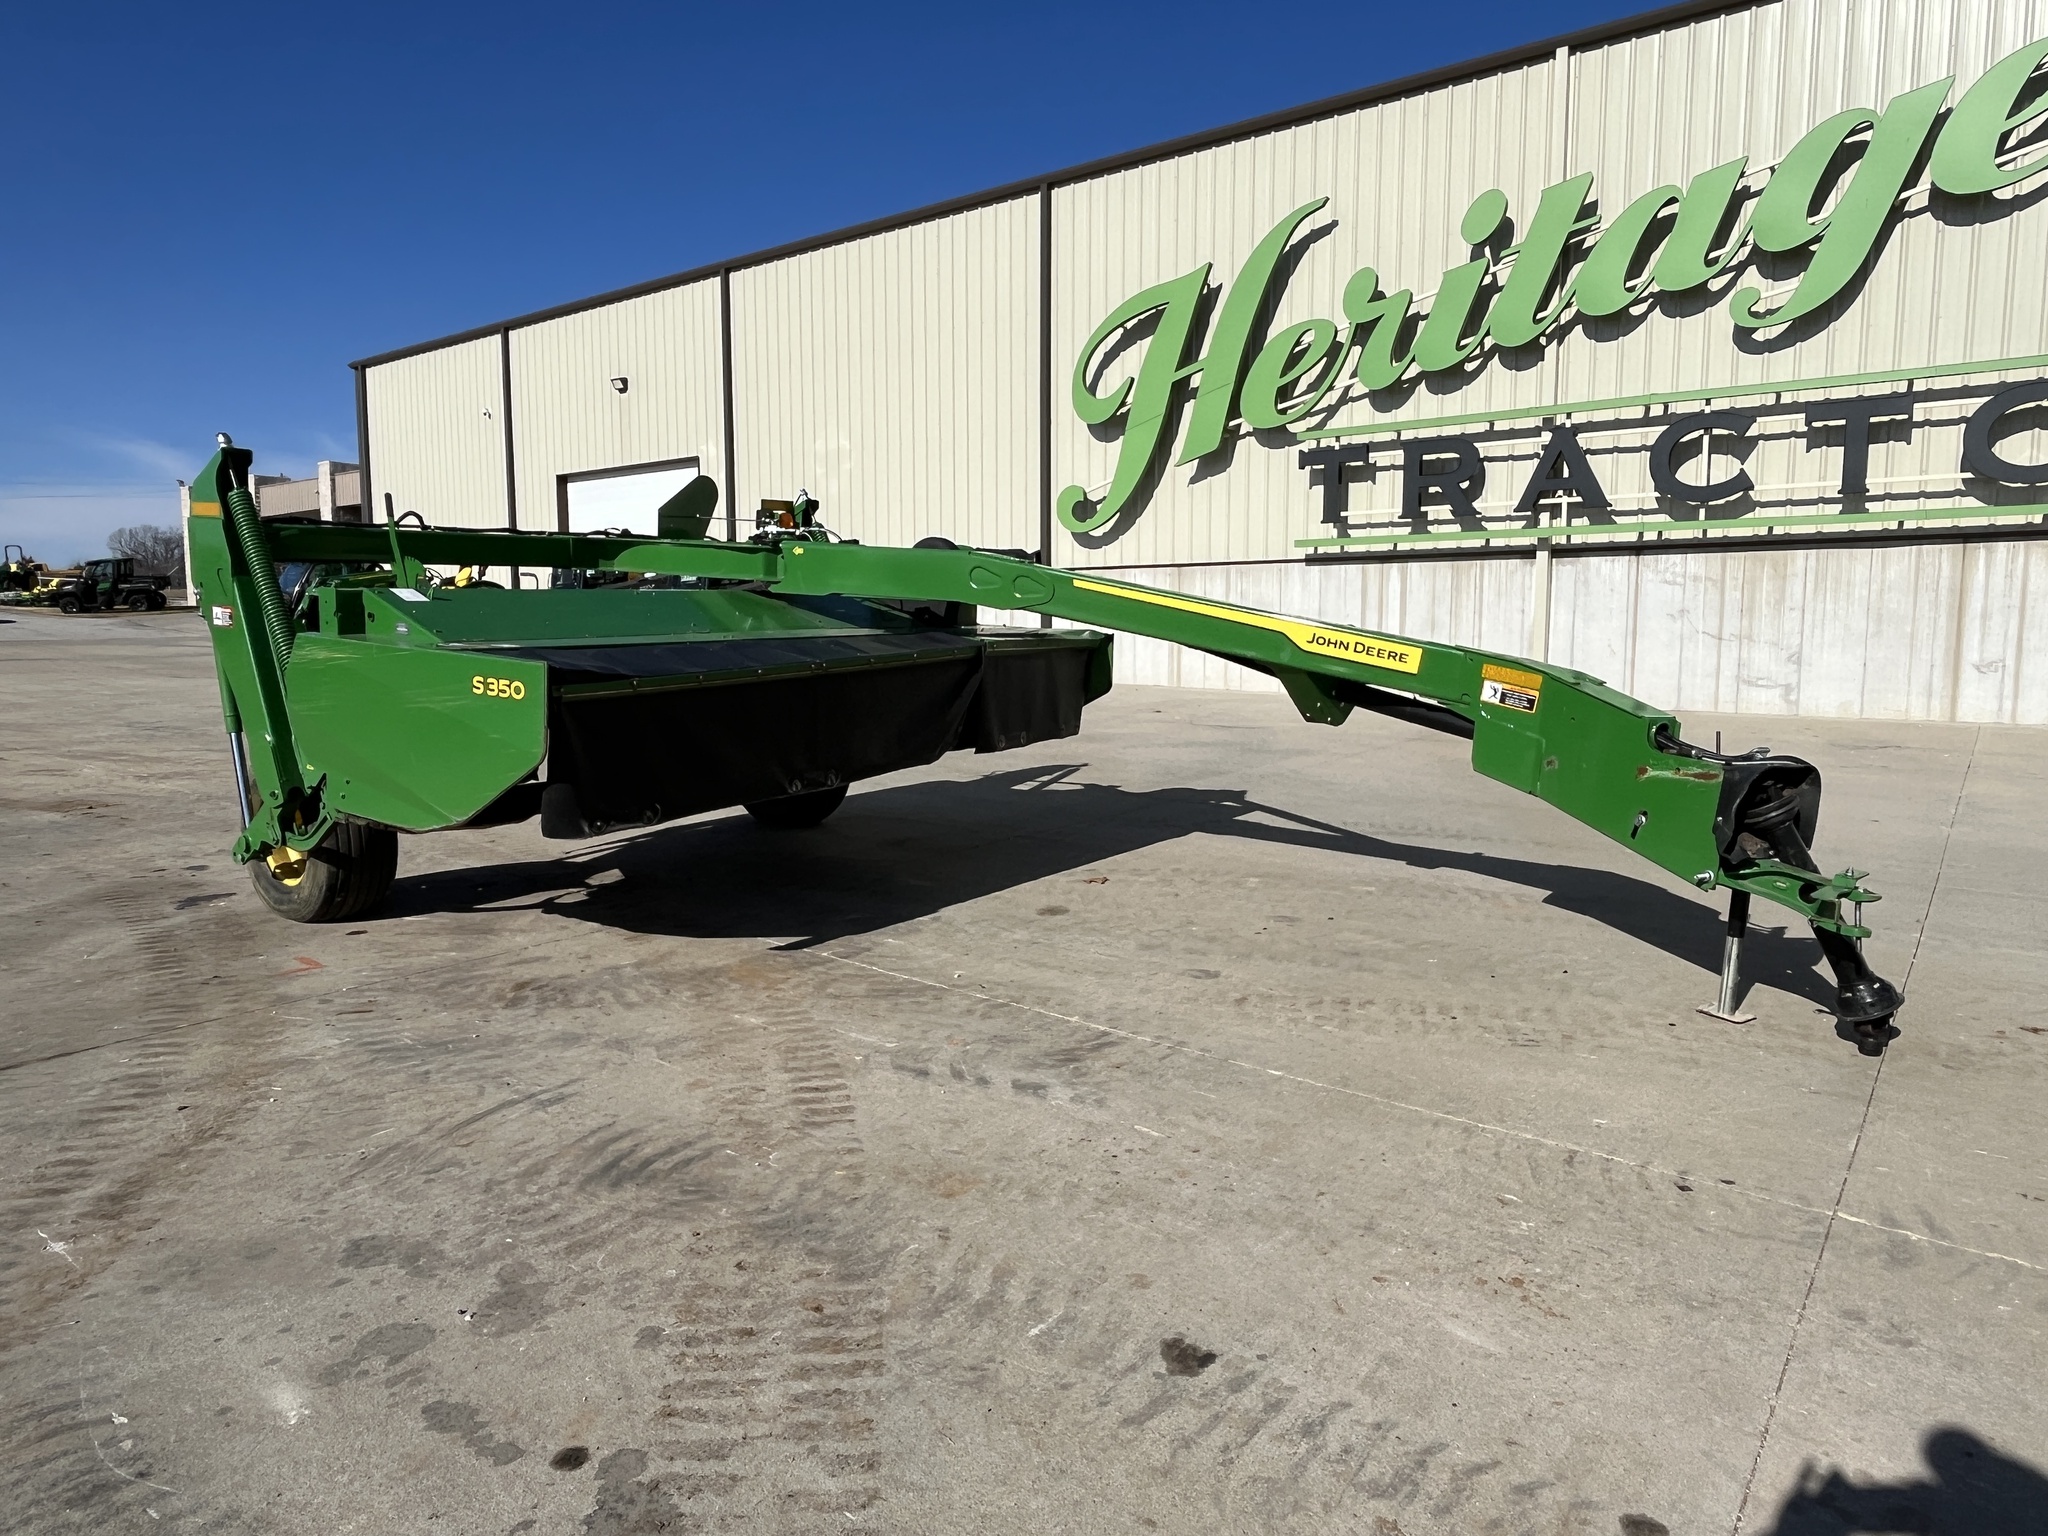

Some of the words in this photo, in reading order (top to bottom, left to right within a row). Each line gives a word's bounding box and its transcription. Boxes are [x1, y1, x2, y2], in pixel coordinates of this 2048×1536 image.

[1056, 36, 2048, 533] Heritage
[1306, 633, 1350, 652] JOHN
[1353, 641, 1409, 664] DEERE
[472, 675, 526, 700] S350
